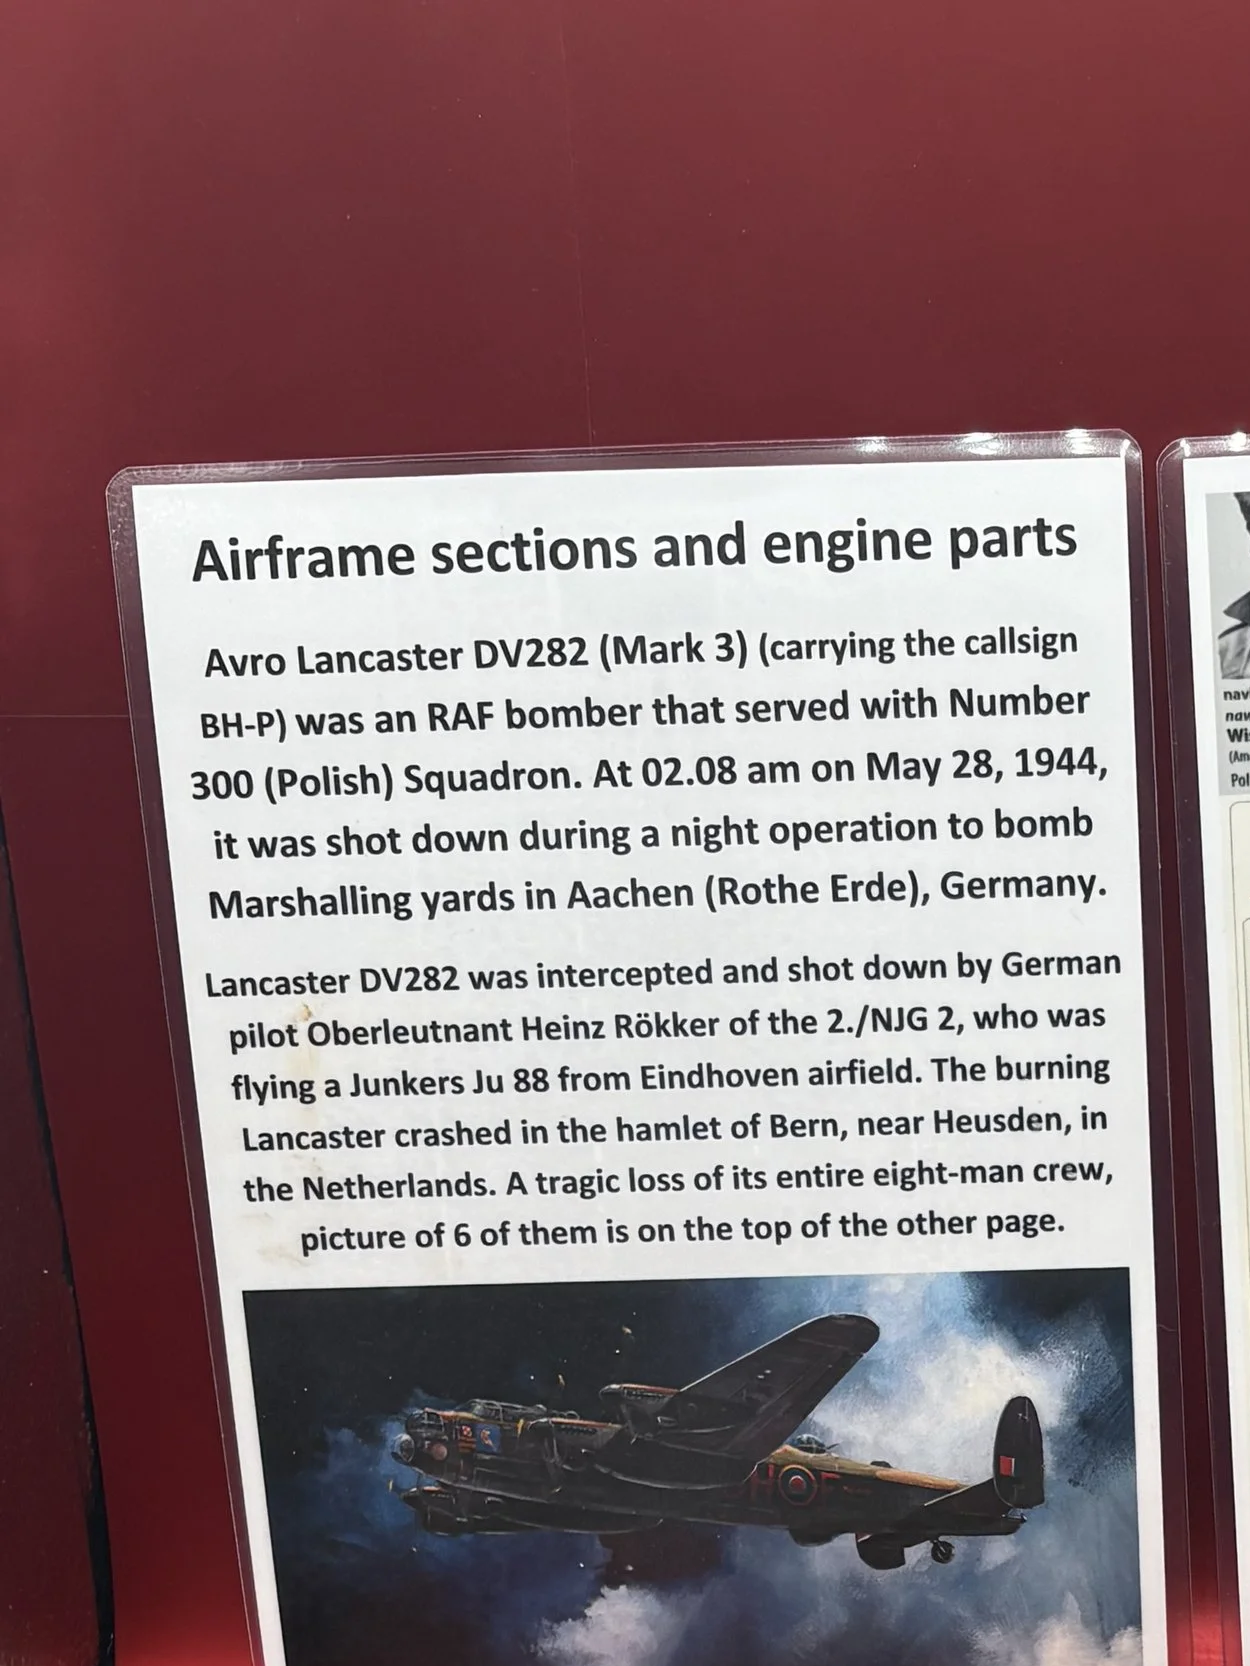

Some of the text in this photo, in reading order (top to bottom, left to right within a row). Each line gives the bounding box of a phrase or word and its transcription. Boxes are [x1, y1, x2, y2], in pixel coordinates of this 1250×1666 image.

[192, 517, 1076, 582] Airframe sections and engine parts
[205, 626, 1077, 677] Avro Lancaster DV282 (Mark 3) (carrying the callsign
[200, 684, 1090, 743] BH-P) was an RAF bomber that served with Number
[190, 746, 1107, 804] 300 (Polish) Squadron. At 02.08 am on May 28, 1944,
[213, 806, 1092, 859] it was shot down during a night operation to bomb
[208, 869, 1106, 921] Marshalling yards in Aachen (Rothe Erde), Germany.
[205, 951, 1120, 997] Lancaster DV282 was intercepted and shot down by German
